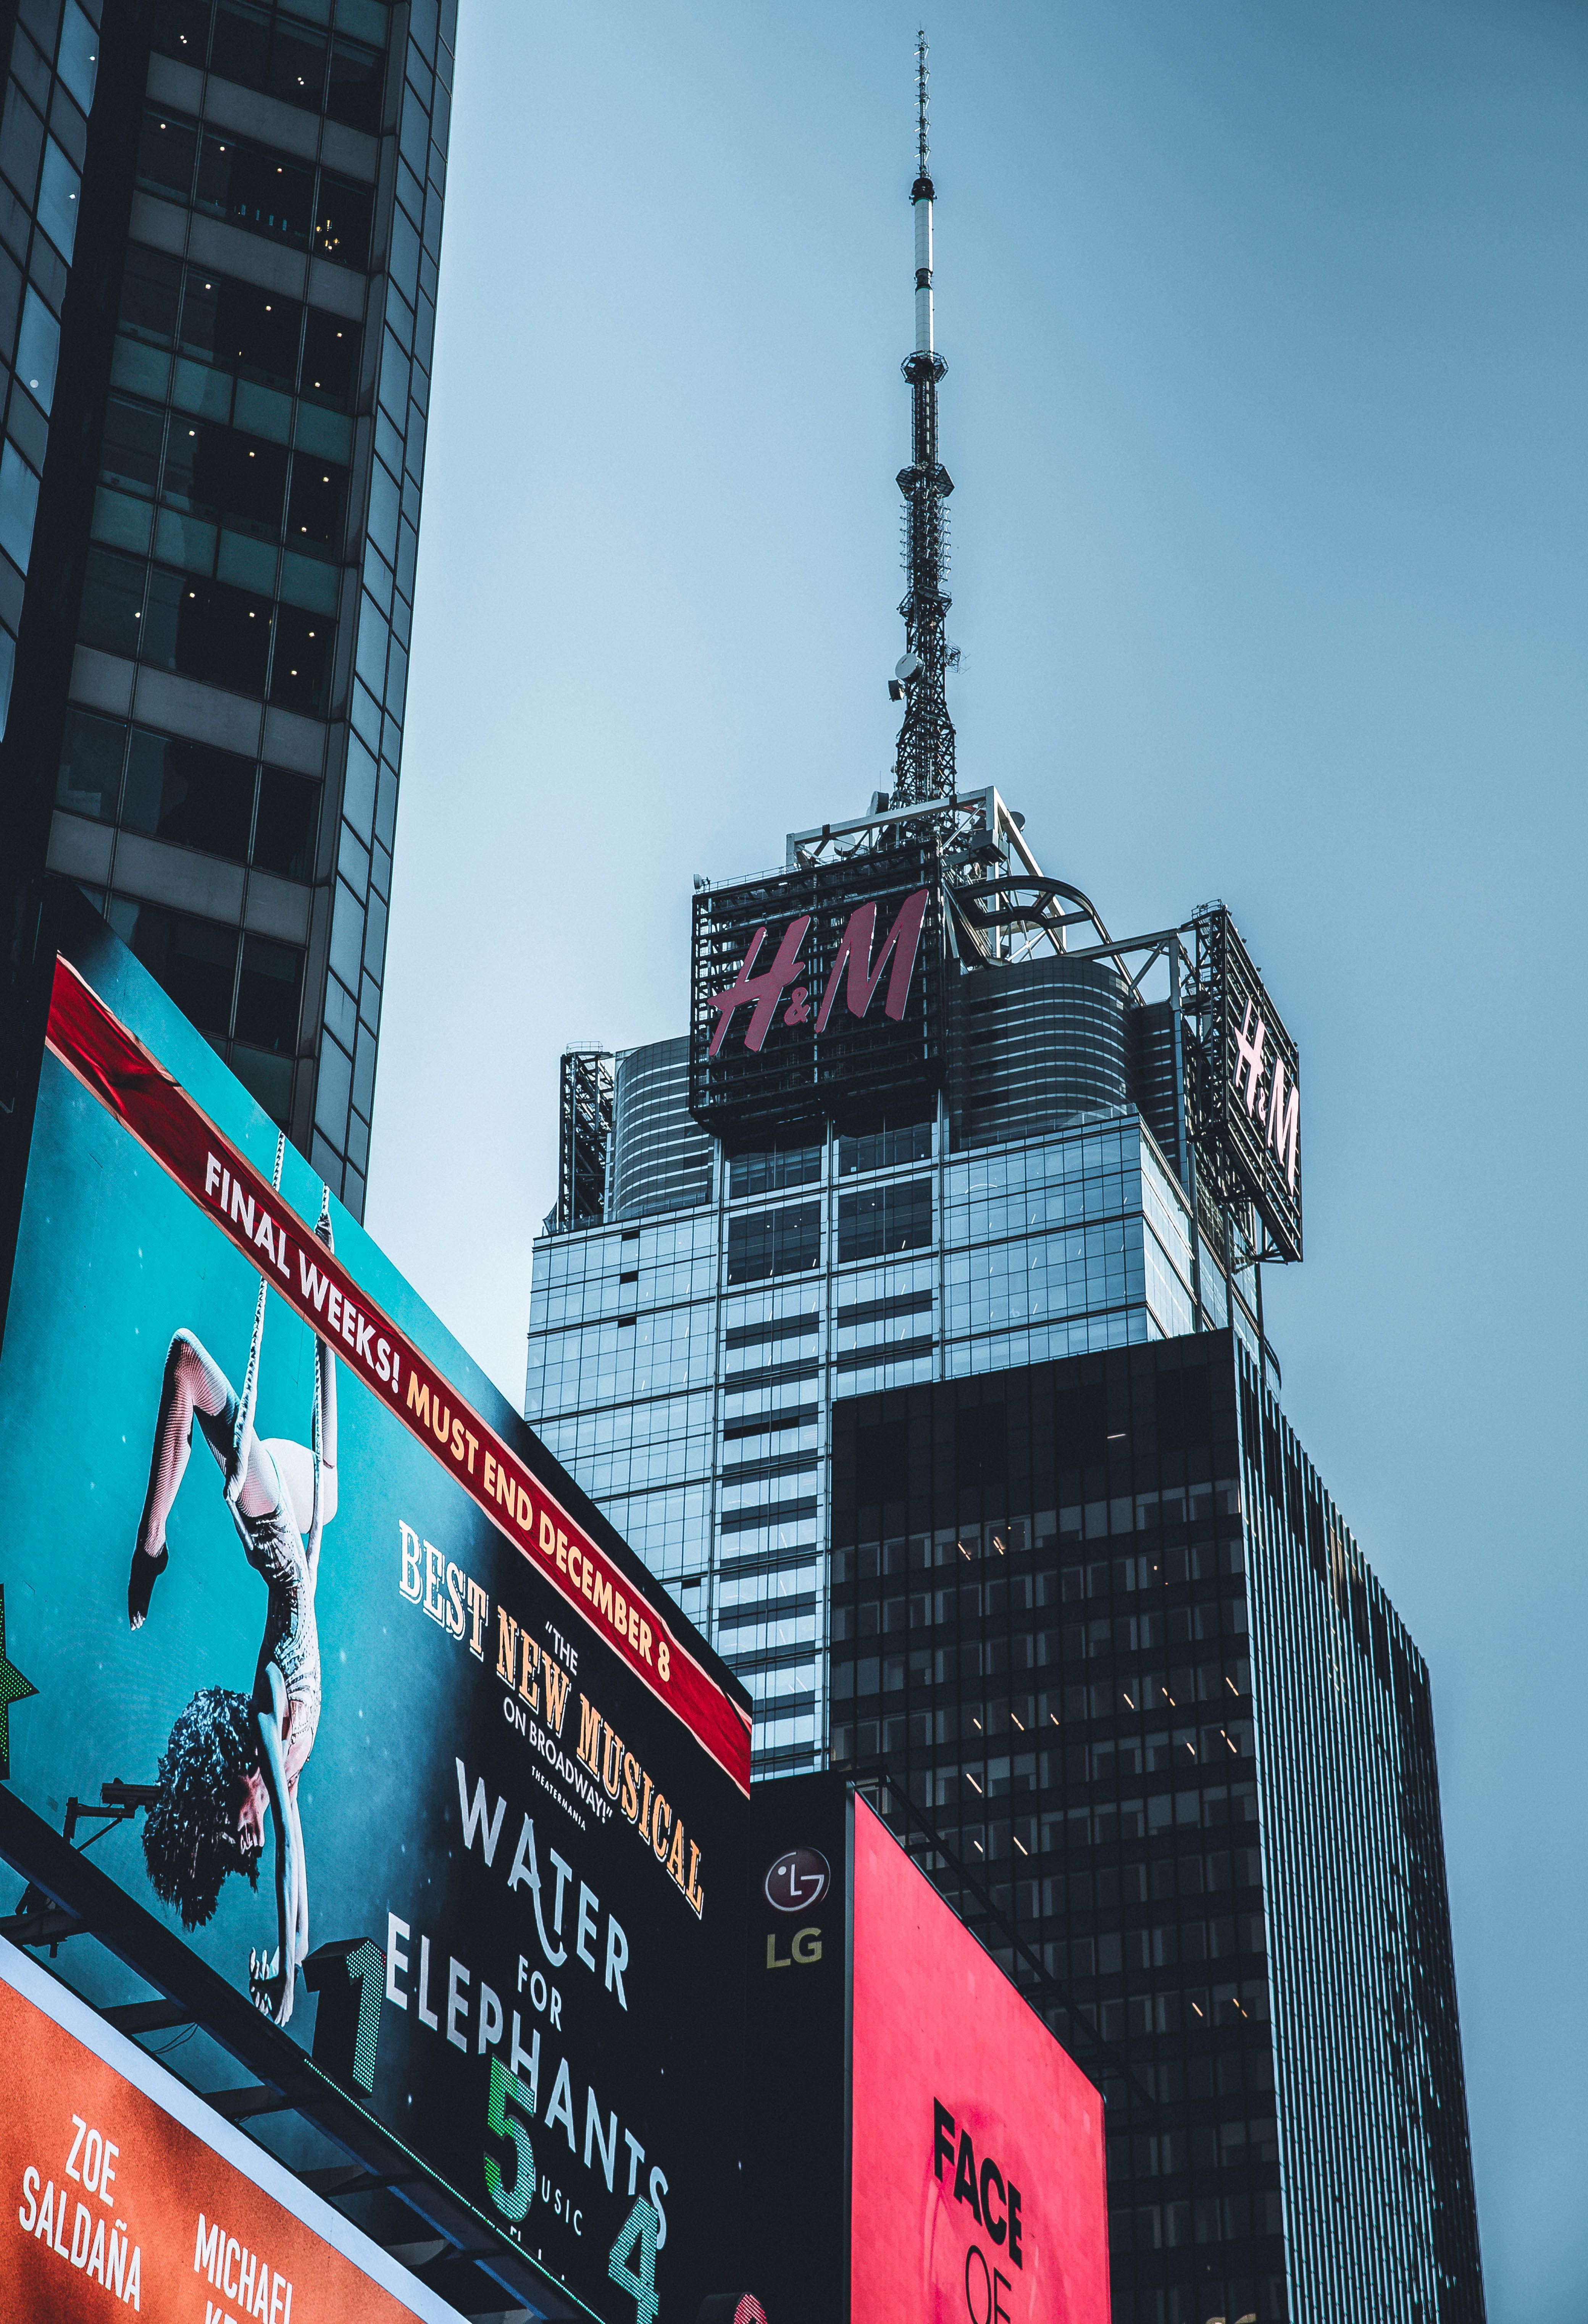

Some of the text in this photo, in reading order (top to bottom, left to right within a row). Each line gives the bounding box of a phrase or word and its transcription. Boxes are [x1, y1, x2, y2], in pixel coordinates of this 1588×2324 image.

[707, 889, 929, 1056] H&M
[1233, 998, 1299, 1197] H&M
[205, 1151, 670, 1682] FINAL WEEKS! MUST END DECEMBER 8
[399, 1519, 703, 1920] BEST NEW MUSICAL
[503, 1697, 525, 1736] ON
[531, 1765, 585, 1831] THEATERMANIA
[455, 1756, 628, 2011] WATER
[767, 1927, 822, 1969] LG
[518, 1954, 562, 2032] FOR
[386, 1912, 668, 2250] ELEPHANTS
[65, 2113, 119, 2208] ZOE
[534, 2166, 582, 2236] USIC
[933, 2096, 1023, 2271] FACE
[19, 2165, 141, 2312] SALDAÑA
[965, 2245, 1012, 2324] OF
